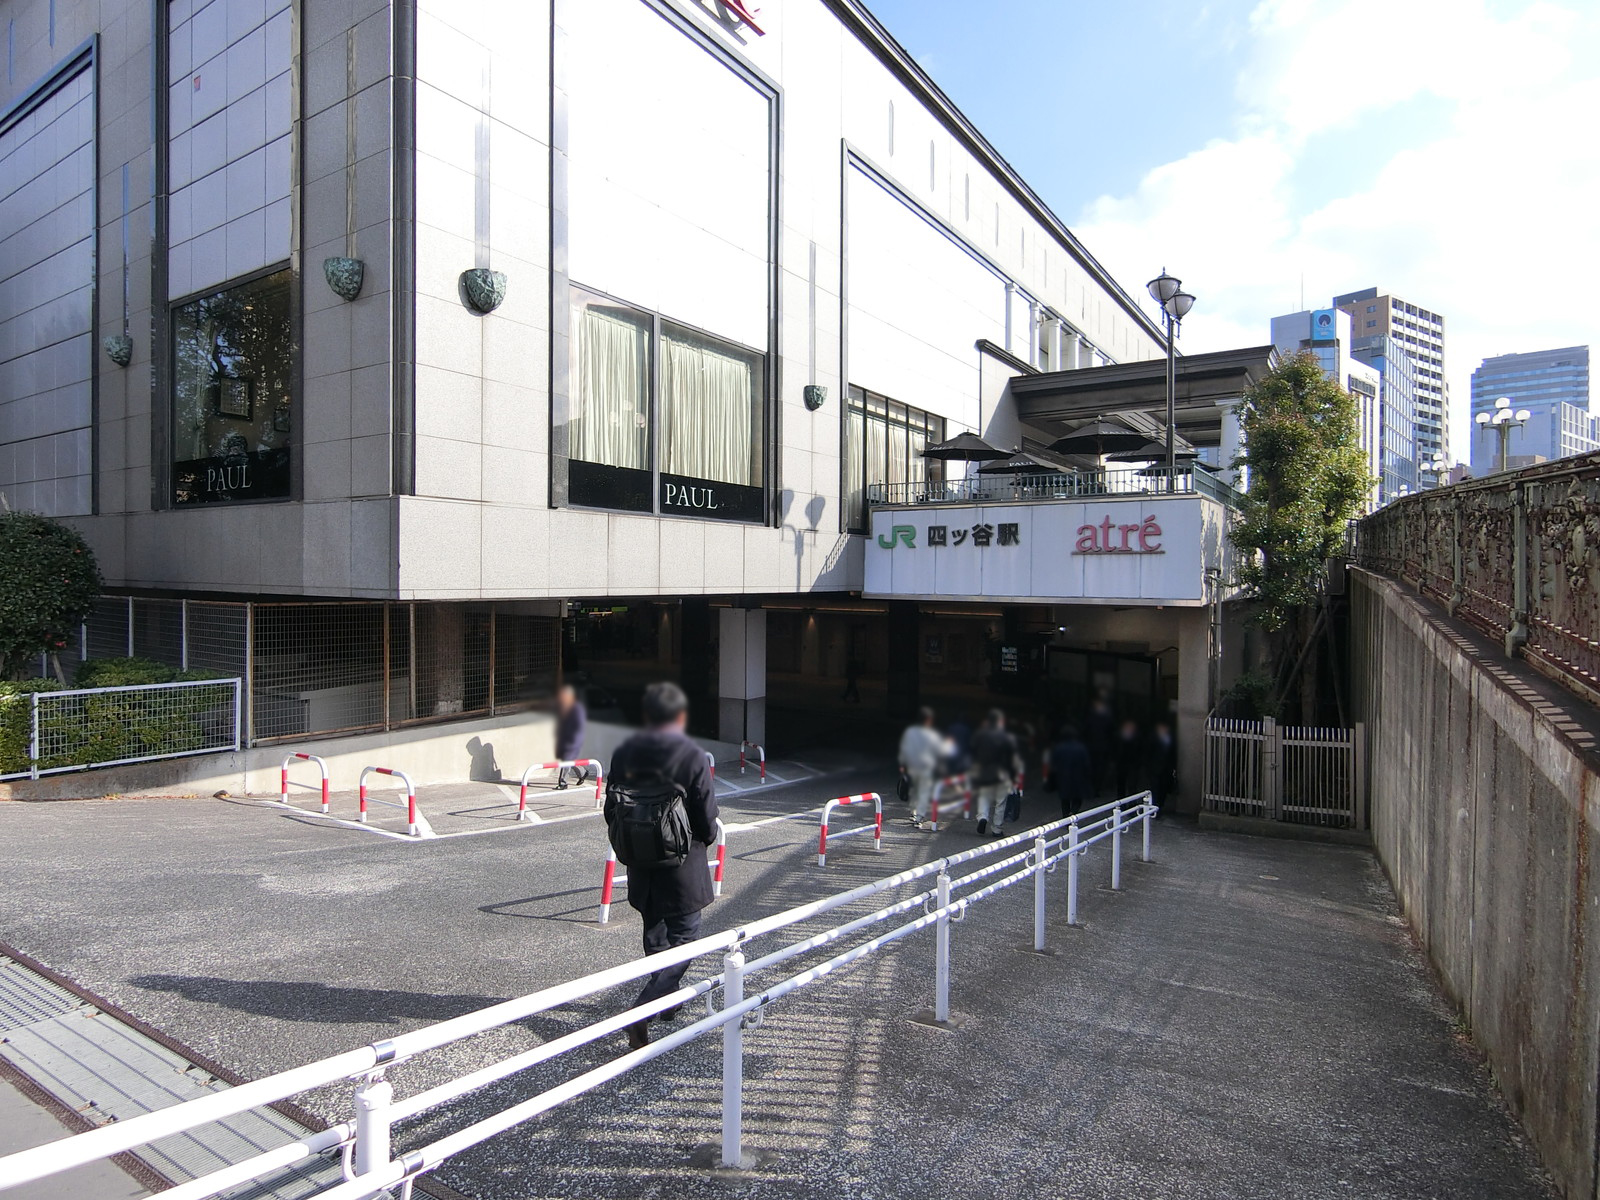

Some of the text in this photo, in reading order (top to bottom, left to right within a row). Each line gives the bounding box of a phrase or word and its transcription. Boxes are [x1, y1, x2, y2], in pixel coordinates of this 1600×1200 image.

[206, 465, 252, 492] PAUL
[664, 483, 718, 509] PAUL
[878, 523, 1020, 549] JR 四ッ谷駅
[1075, 514, 1162, 552] atré
